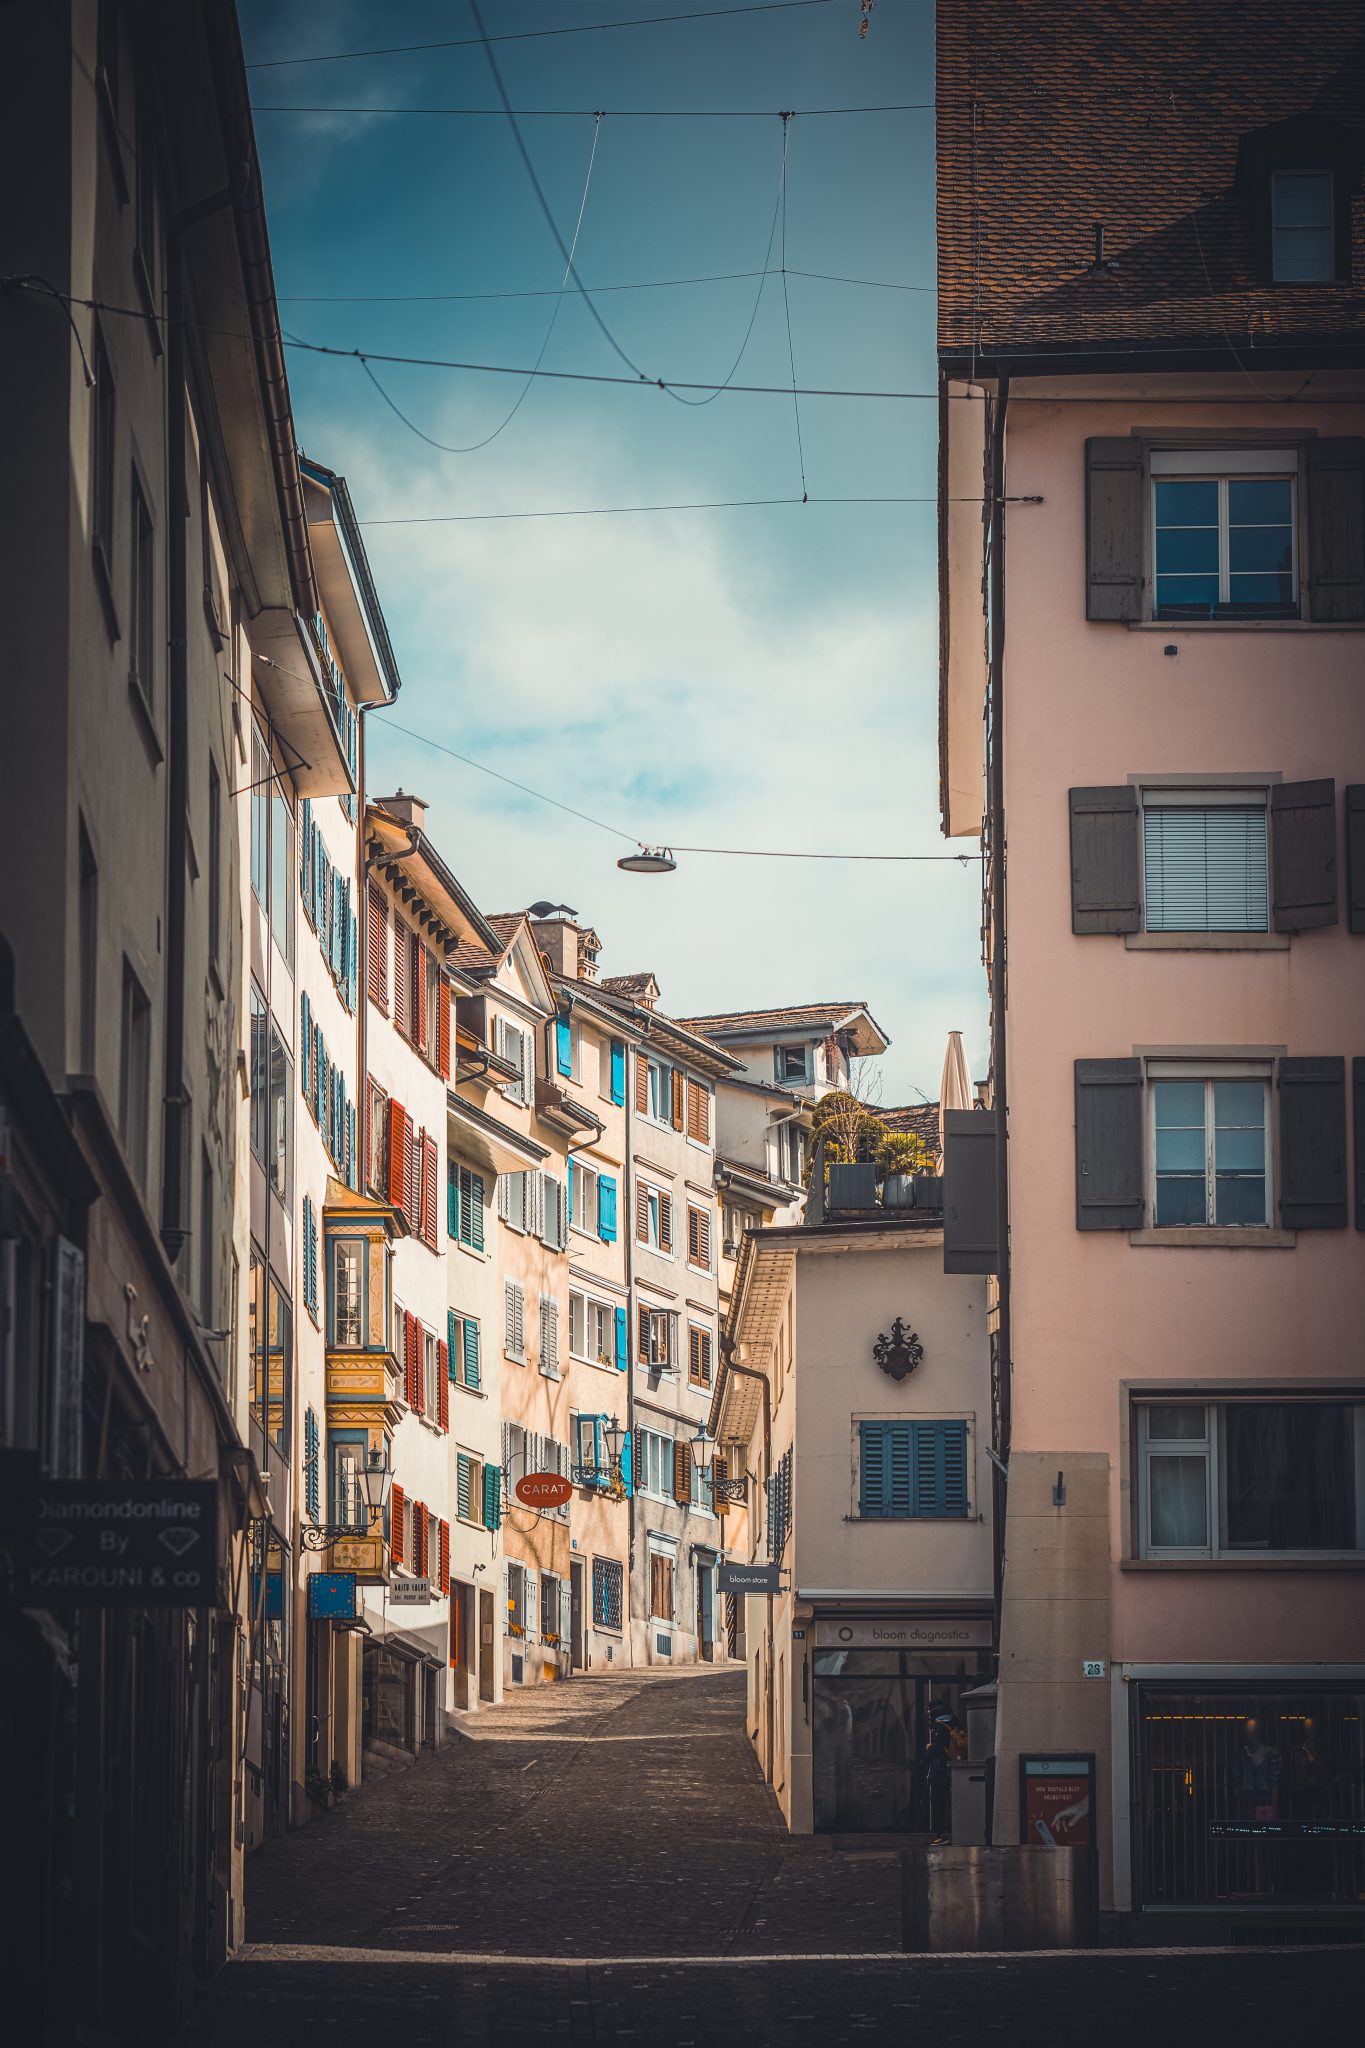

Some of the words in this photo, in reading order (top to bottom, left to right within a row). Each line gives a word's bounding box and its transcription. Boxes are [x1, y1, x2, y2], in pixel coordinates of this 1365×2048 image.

[522, 1484, 566, 1495] CARAT
[99, 1530, 131, 1556] By
[29, 1566, 143, 1588] KAROUNI
[149, 1566, 166, 1588] &
[173, 1571, 201, 1587] co
[729, 1574, 752, 1583] bloom
[872, 1628, 907, 1640] bloom
[911, 1628, 971, 1643] diagnostics
